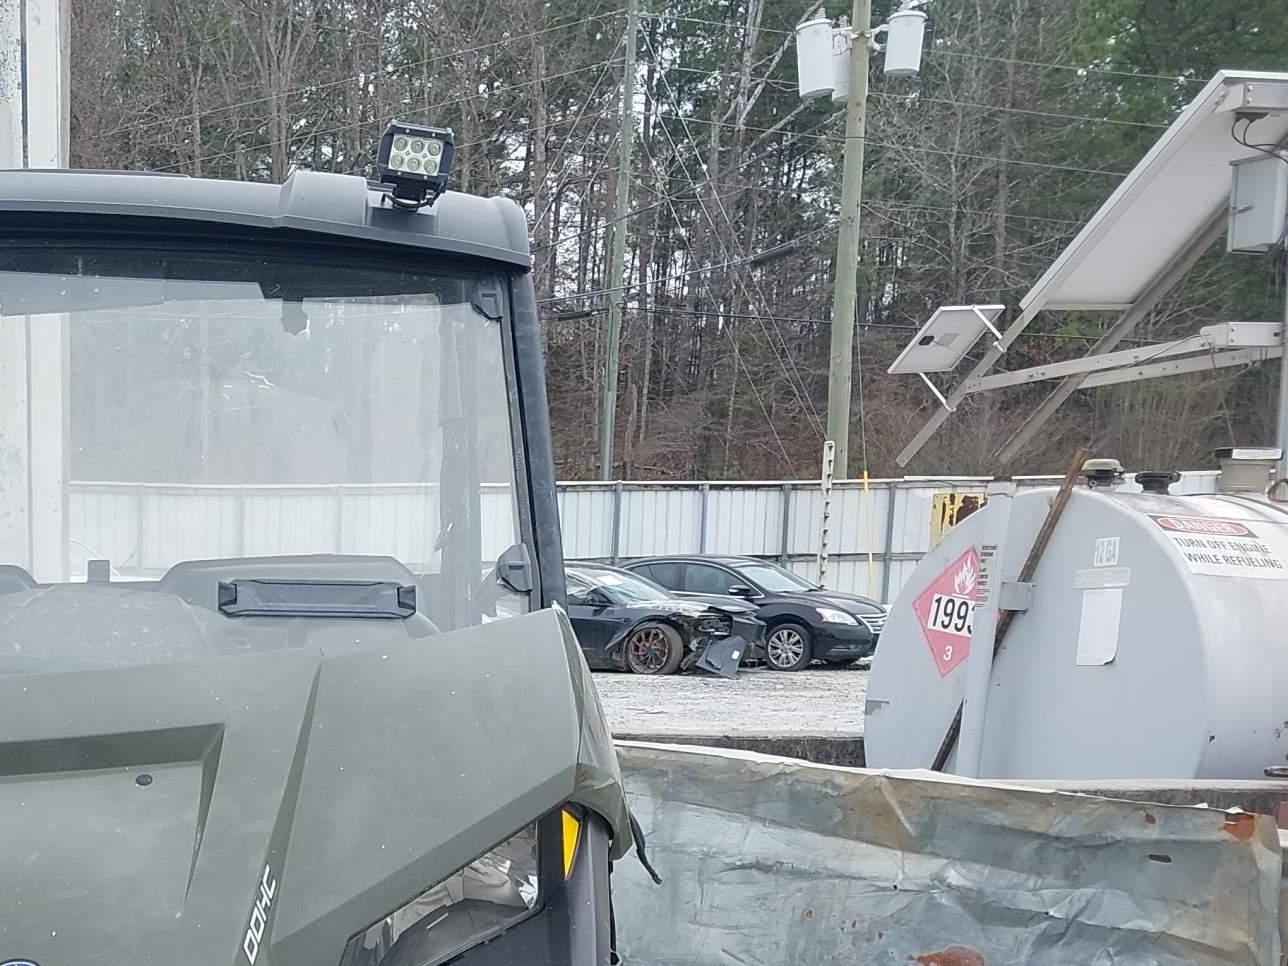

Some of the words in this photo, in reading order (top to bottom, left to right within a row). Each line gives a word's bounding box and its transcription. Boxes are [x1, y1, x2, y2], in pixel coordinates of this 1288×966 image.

[1169, 518, 1238, 534] DANGER
[1172, 537, 1207, 549] TURN
[1206, 539, 1228, 550] OFF
[1230, 542, 1273, 554] ENGINE
[1183, 552, 1222, 565] WHILE
[1223, 555, 1284, 569] REFUELING
[943, 645, 953, 661] 3
